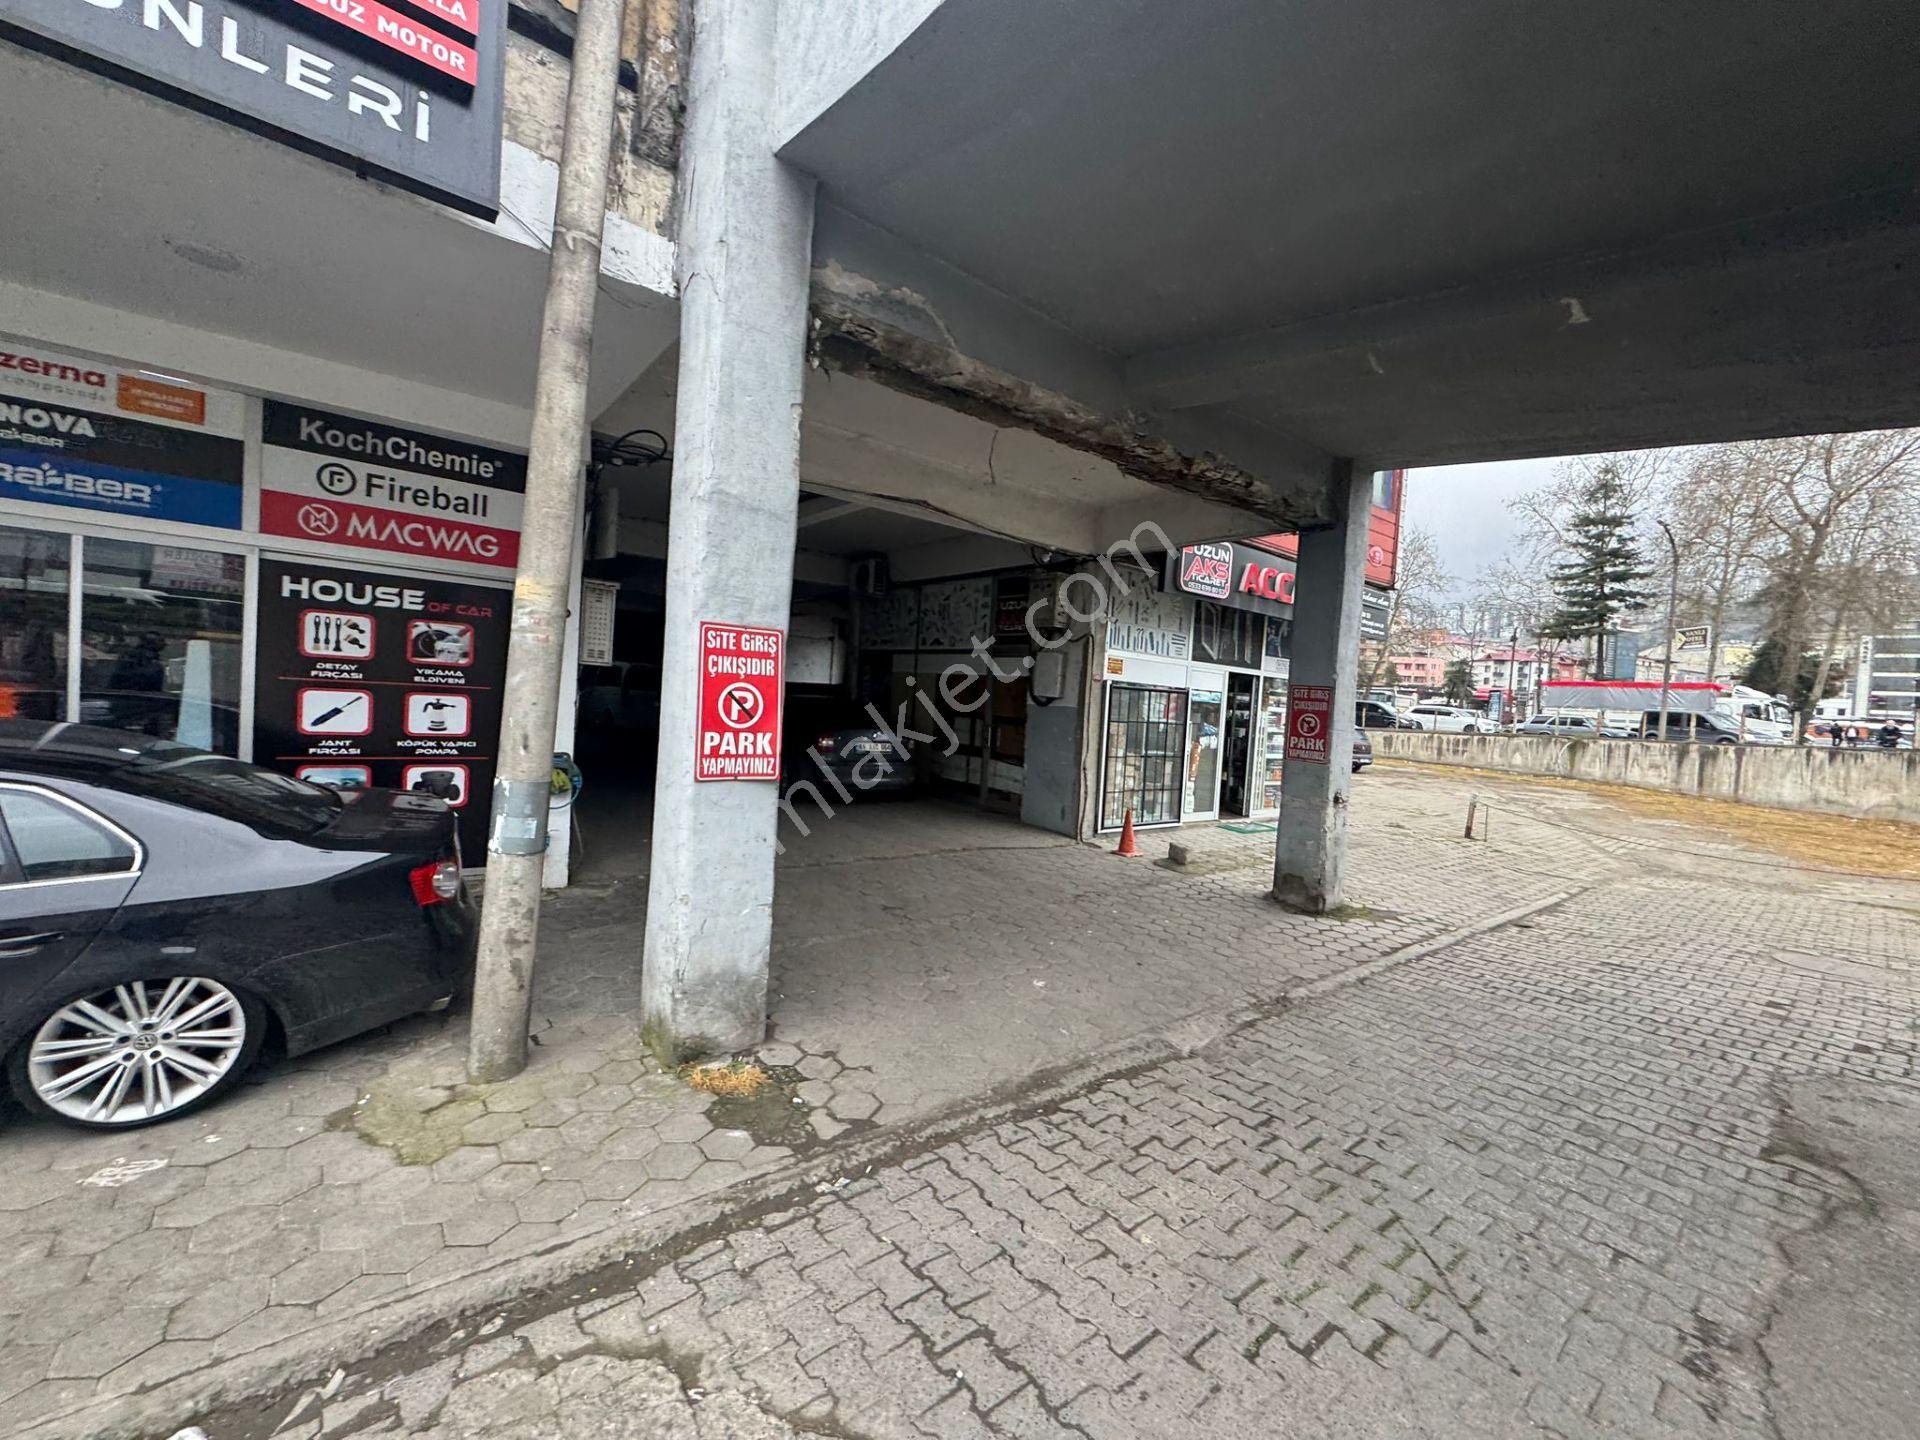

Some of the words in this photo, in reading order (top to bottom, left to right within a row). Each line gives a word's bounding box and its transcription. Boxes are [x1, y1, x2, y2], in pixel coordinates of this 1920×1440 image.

[376, 14, 466, 72] MOTOR
[299, 417, 495, 478] KochChemie
[365, 472, 488, 518] Fireball
[346, 512, 499, 557] MACWAG
[1194, 544, 1230, 563] UZUN
[1183, 555, 1229, 581] AKS
[1238, 562, 1295, 604] ACC
[281, 575, 426, 611] HOUSE
[427, 603, 450, 614] OF
[455, 603, 493, 618] CAR
[315, 662, 358, 670] DETAY
[708, 654, 775, 679] ÇIKIŞIDIR
[415, 748, 459, 756] POMPA
[703, 732, 773, 756] PARK
[1290, 736, 1325, 751] PARK
[702, 757, 775, 776] YAPMAYINIZ
